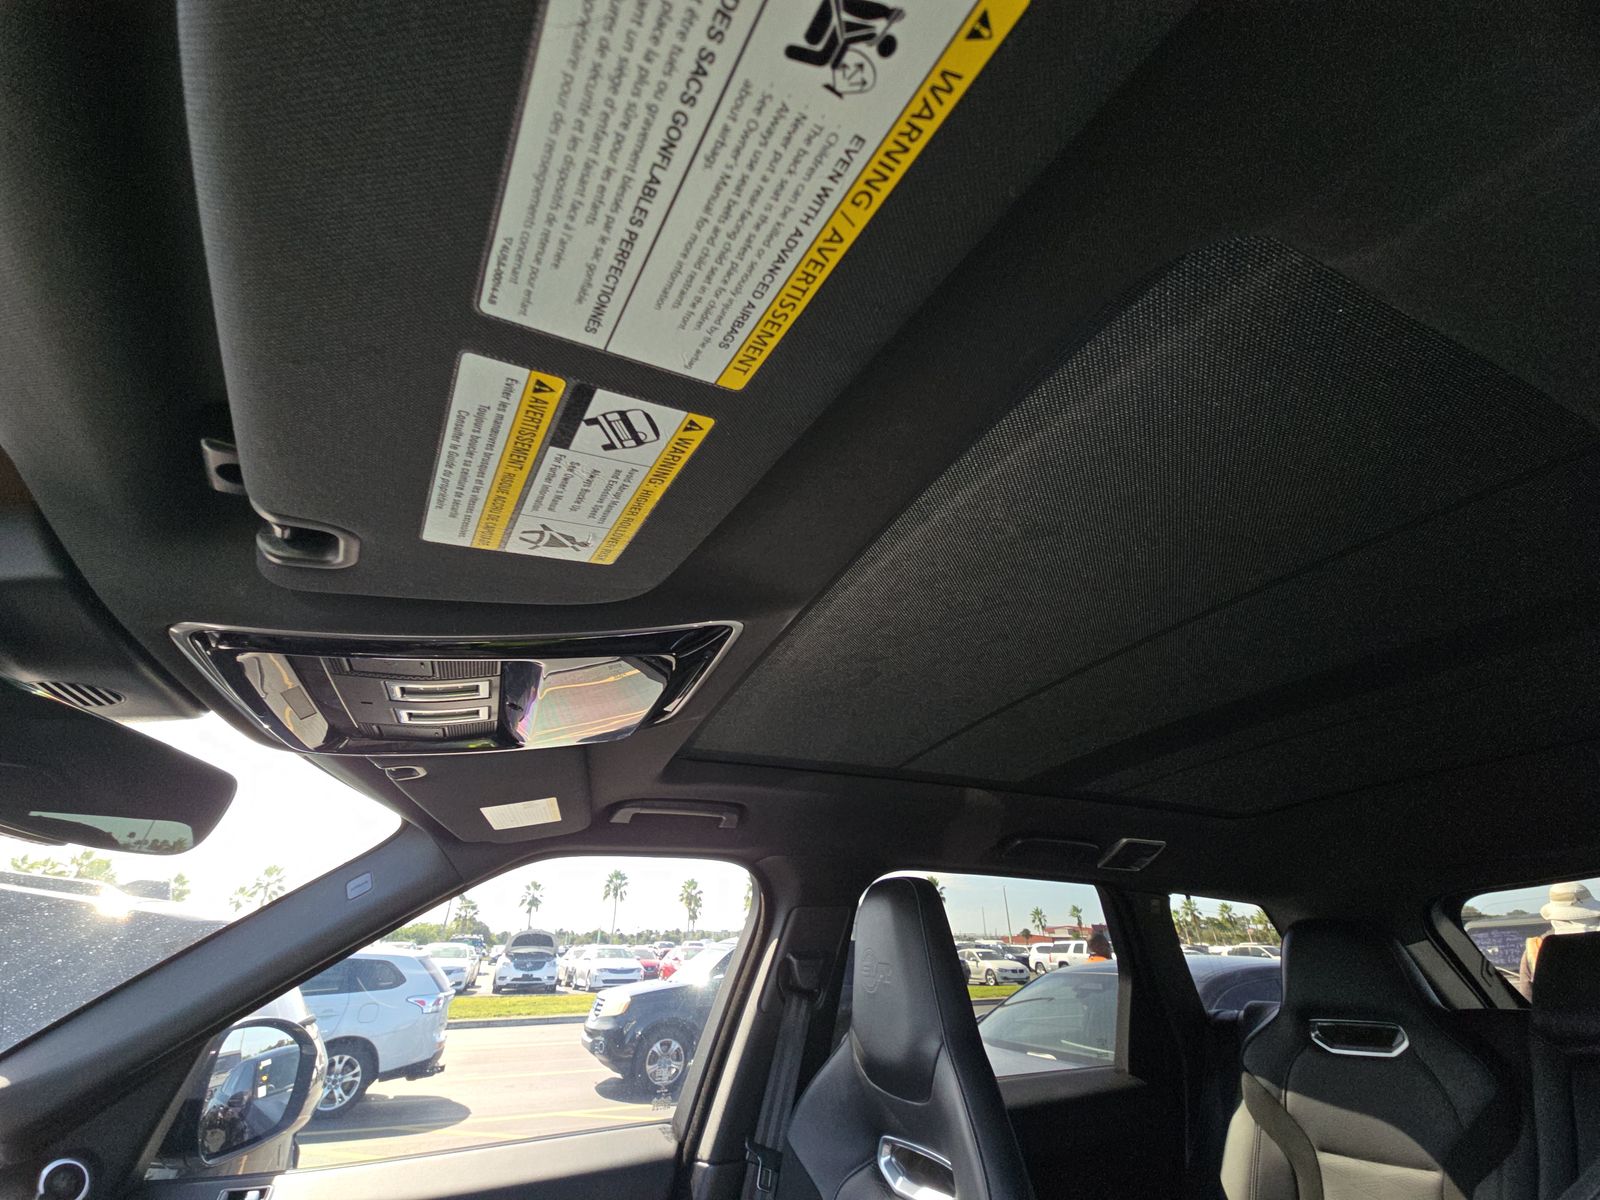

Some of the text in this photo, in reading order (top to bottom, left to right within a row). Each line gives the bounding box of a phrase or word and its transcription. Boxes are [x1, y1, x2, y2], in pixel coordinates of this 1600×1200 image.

[595, 35, 611, 59] de
[621, 28, 637, 53] un
[641, 47, 659, 64] la
[556, 70, 574, 110] pour
[629, 63, 650, 98] plus
[679, 46, 715, 107] SACS
[652, 79, 668, 102] ou
[726, 78, 752, 122] about
[752, 91, 773, 116] See
[547, 110, 565, 136] des
[571, 117, 585, 134] et
[618, 99, 638, 131] sûre
[757, 101, 789, 147] Always
[565, 134, 583, 152] les
[625, 102, 659, 173] gravement
[724, 118, 759, 170] Owner's
[780, 111, 807, 150] Never
[802, 123, 824, 144] The
[850, 69, 962, 209] WARNING
[607, 130, 626, 165] pour
[745, 149, 762, 172] use
[785, 143, 810, 175] back
[802, 131, 839, 182] Children
[600, 165, 617, 182] les
[628, 110, 688, 227] GONFLABLES
[765, 149, 783, 174] put
[609, 174, 634, 214] blessés
[702, 171, 731, 216] Manual
[731, 172, 749, 198] seat
[769, 177, 788, 202] seat
[787, 182, 805, 204] can
[543, 211, 558, 227] de
[565, 198, 584, 222] face
[602, 213, 615, 234] par
[716, 197, 739, 224] belts
[725, 184, 764, 241] rear-facing
[752, 213, 768, 232] the
[778, 204, 794, 220] be
[693, 215, 709, 233] for
[705, 224, 721, 247] and
[761, 220, 784, 248] killed
[532, 227, 551, 266] retenue
[590, 245, 604, 262] sac
[679, 232, 698, 260] more
[713, 241, 731, 266] child
[717, 133, 865, 349] EVEN WITH ADVANCED AIRBAGS
[734, 232, 756, 261] safest
[508, 230, 530, 285] concernant
[692, 245, 710, 271] child
[526, 264, 539, 289] pour
[584, 229, 638, 333] PERFECTIONNÉS
[702, 265, 718, 285] seat
[720, 259, 739, 285] place
[729, 260, 758, 297] seriously
[712, 285, 727, 300] for
[733, 227, 843, 374] AVERTISSEMENT
[712, 297, 734, 326] injured
[505, 396, 548, 471] AVERTISSEMENT:
[645, 437, 694, 487] WARNING:
[495, 471, 516, 495] RISQUE
[625, 488, 652, 516] HIGHER
[604, 516, 634, 548] ROLLOVER
